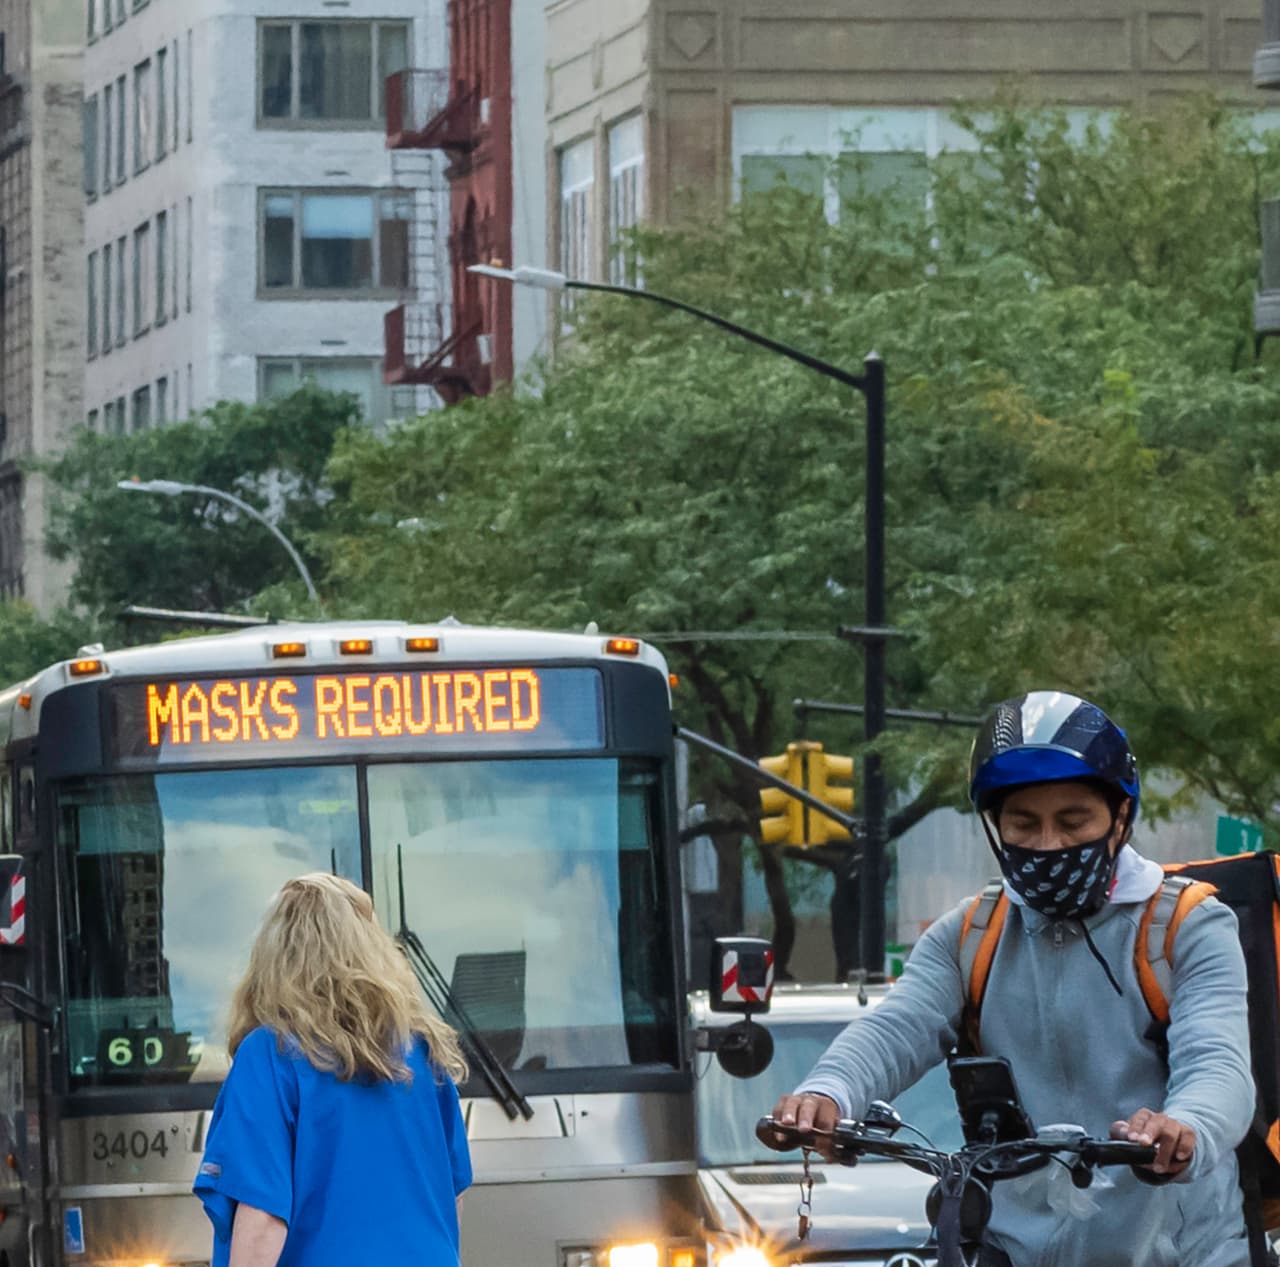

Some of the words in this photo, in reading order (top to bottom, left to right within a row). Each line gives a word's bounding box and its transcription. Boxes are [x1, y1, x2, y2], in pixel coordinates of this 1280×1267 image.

[146, 678, 300, 746] MASKS
[314, 668, 542, 739] REQUIRED
[92, 1129, 169, 1161] 3404
